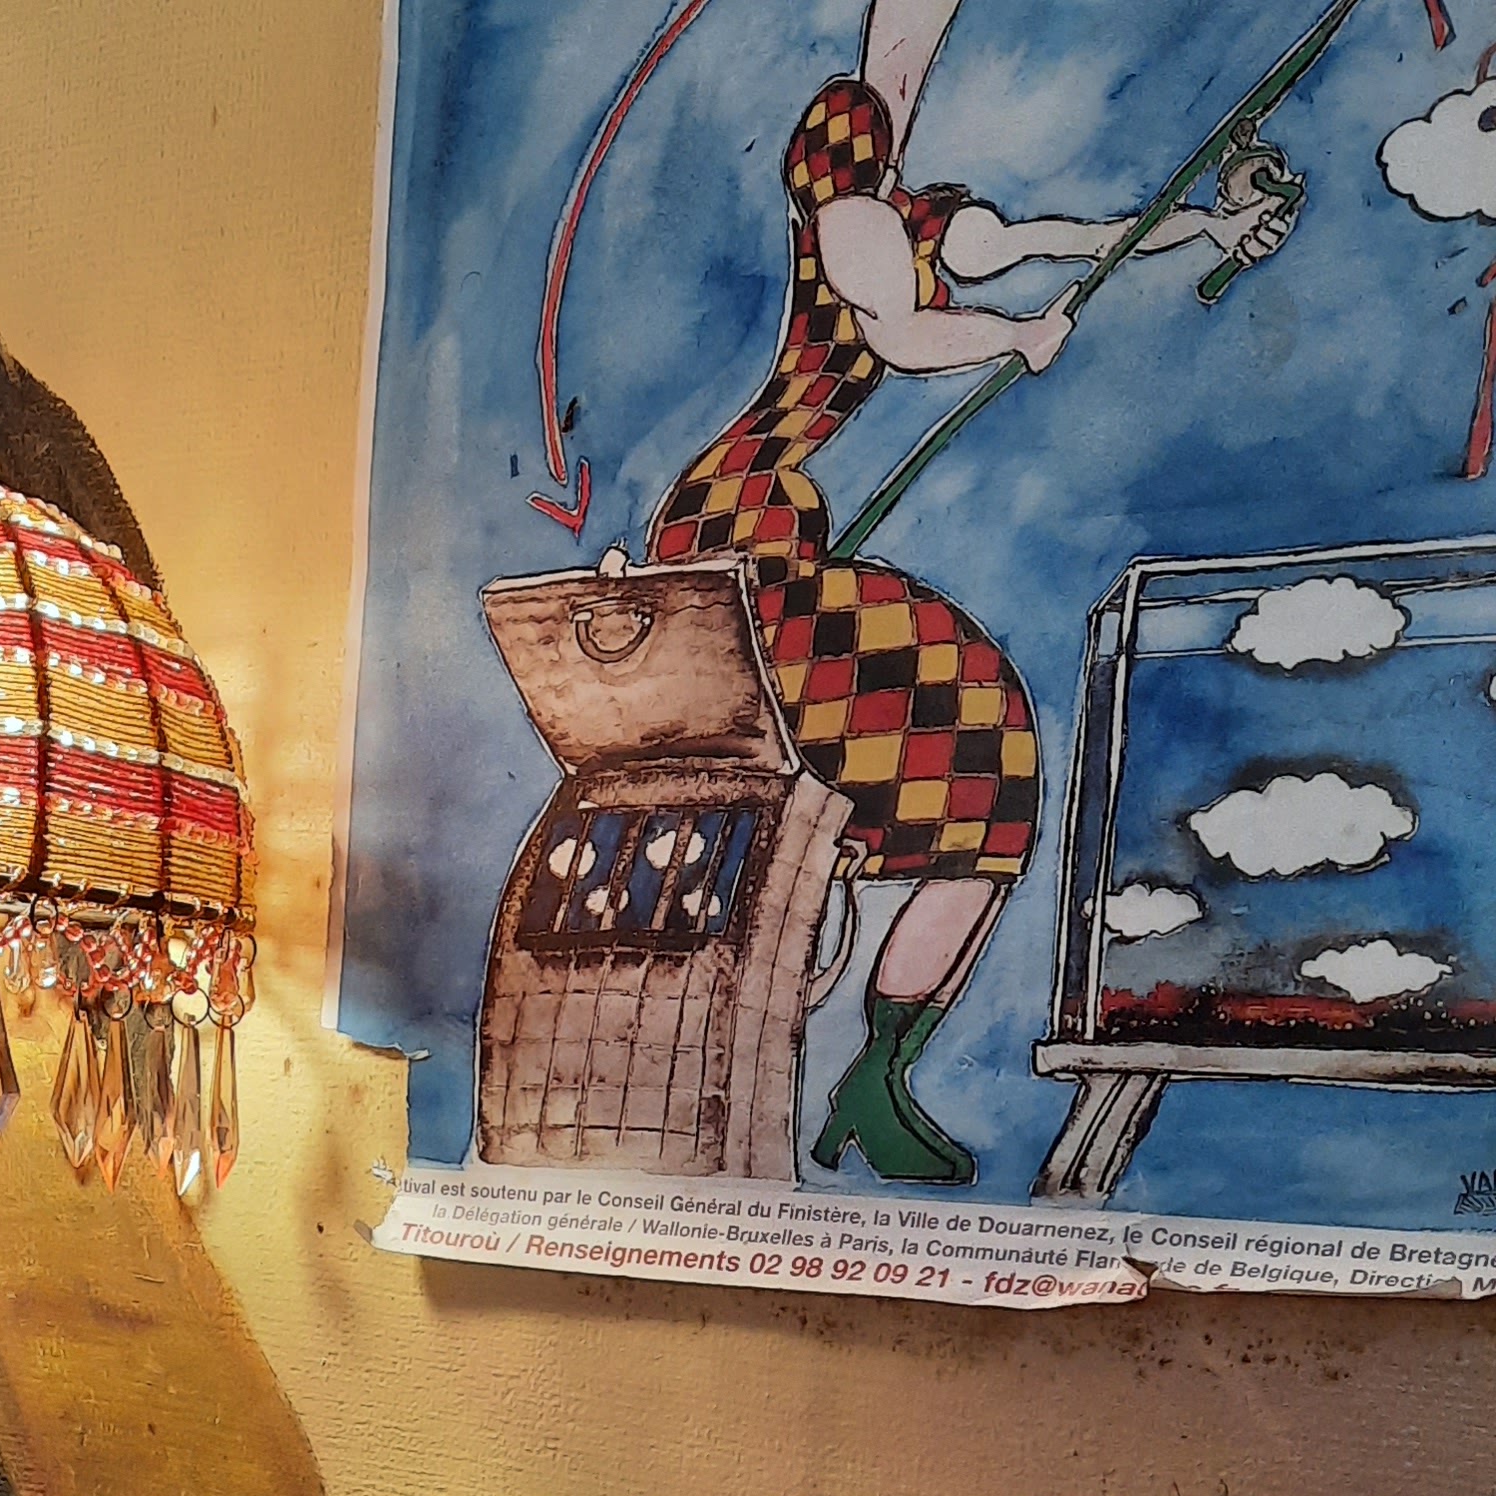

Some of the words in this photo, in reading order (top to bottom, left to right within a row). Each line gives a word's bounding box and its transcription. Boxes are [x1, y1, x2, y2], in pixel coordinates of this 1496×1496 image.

[398, 1178, 436, 1195] tival
[440, 1182, 466, 1197] est
[470, 1182, 538, 1202] soutenu
[543, 1190, 572, 1206] par
[577, 1189, 592, 1205] le
[598, 1191, 664, 1211] Conseil
[670, 1195, 742, 1217] Général
[747, 1201, 772, 1219] du
[777, 1202, 866, 1228] Finistère,
[873, 1210, 890, 1227] la
[898, 1210, 939, 1230] Ville
[946, 1214, 971, 1232] de
[978, 1216, 1116, 1245] Douarnenez,
[1122, 1225, 1144, 1244] le
[1151, 1227, 1238, 1251] Conseil
[1244, 1234, 1343, 1258] régional
[1350, 1241, 1381, 1260] de
[431, 1203, 447, 1218] la
[452, 1205, 542, 1226] Délégation
[547, 1213, 623, 1233] générale
[642, 1218, 814, 1248] Wallonie-Bruxelles
[820, 1231, 832, 1249] à
[838, 1233, 894, 1257] Paris,
[901, 1237, 919, 1256] la
[926, 1239, 1068, 1266] Communauté
[1193, 1259, 1222, 1276] de
[1229, 1261, 1339, 1287] Belgique,
[524, 1234, 742, 1272] Renseignements
[749, 1252, 783, 1275] 02
[789, 1255, 824, 1279] 98
[830, 1258, 867, 1282] 92
[873, 1262, 909, 1285] 09
[915, 1265, 950, 1289] 21
